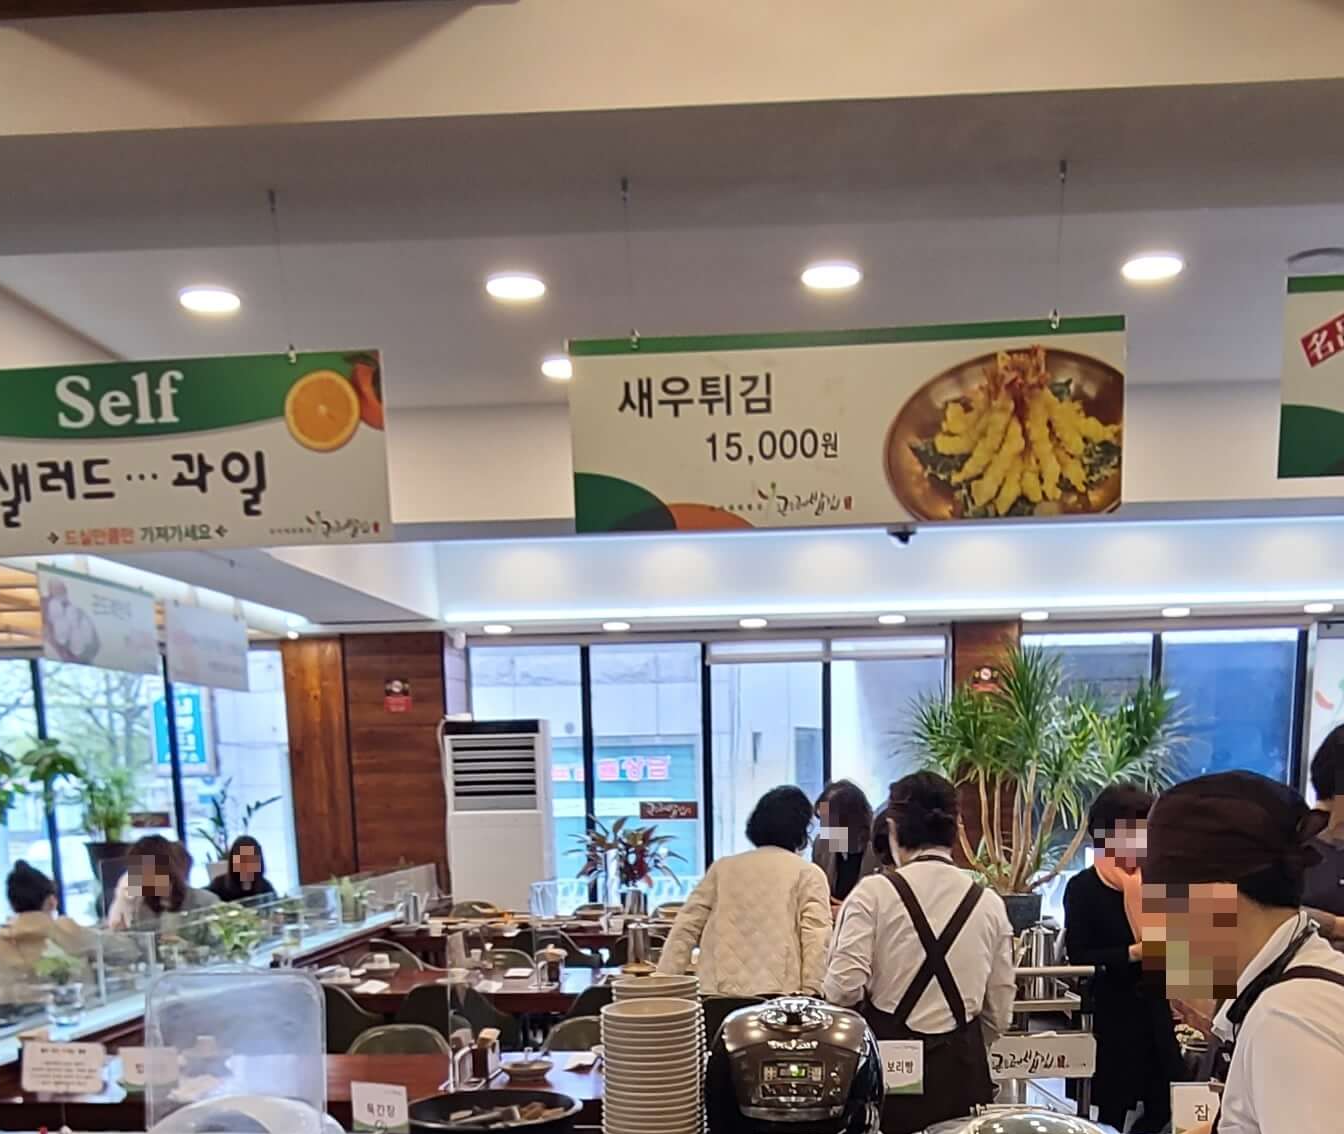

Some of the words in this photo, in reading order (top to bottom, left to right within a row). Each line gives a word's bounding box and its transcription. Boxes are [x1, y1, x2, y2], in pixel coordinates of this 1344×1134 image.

[55, 370, 183, 429] Self
[617, 371, 774, 419] 새우튀김
[704, 428, 839, 465] 15,000원
[171, 449, 267, 517] 과일
[64, 526, 135, 546] 드실만큼만
[139, 523, 212, 543] 가져가세요
